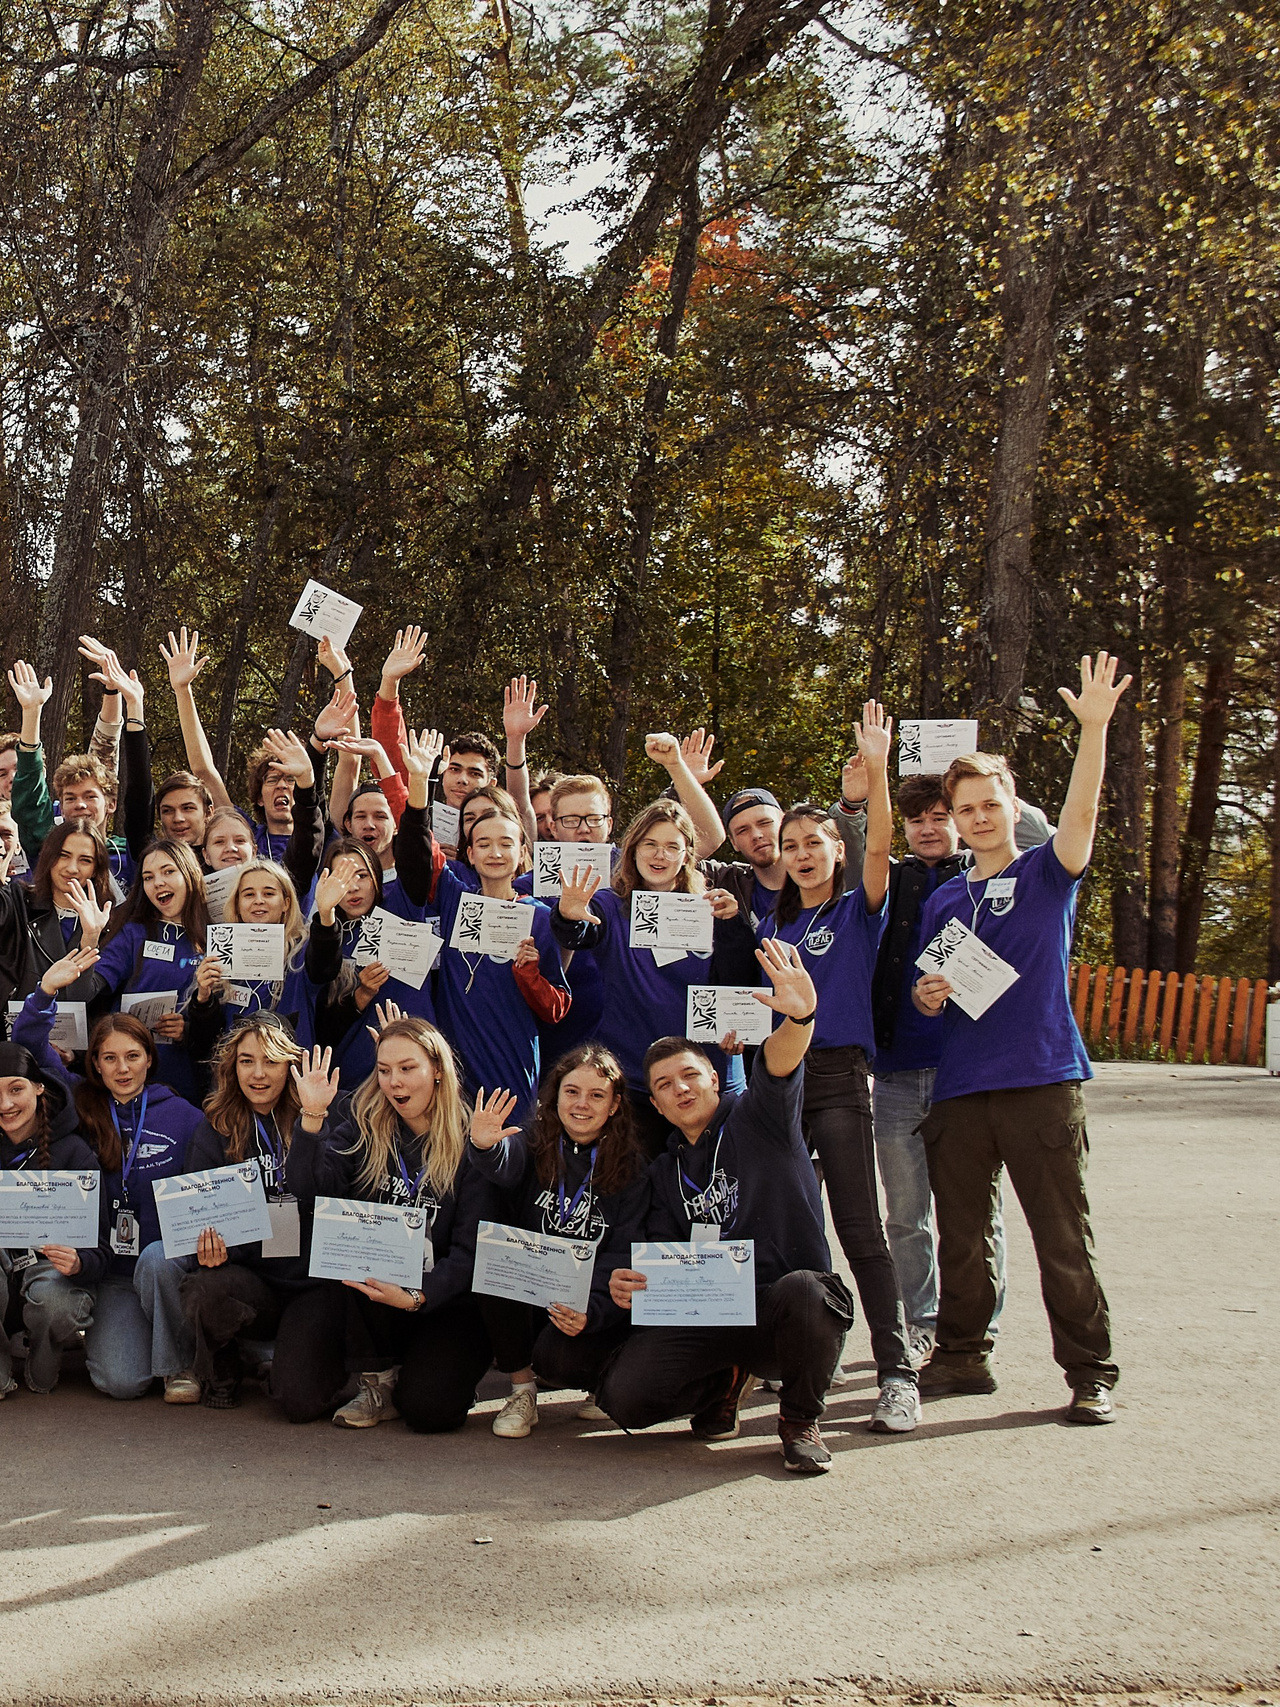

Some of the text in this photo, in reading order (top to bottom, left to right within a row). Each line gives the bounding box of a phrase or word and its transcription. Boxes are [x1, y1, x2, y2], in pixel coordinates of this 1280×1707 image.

[146, 943, 170, 956] СВЕТА
[234, 990, 248, 1002] ЕСЯ
[181, 1177, 235, 1191] БЛАГОДАРСТВЕННОЕ
[342, 1211, 398, 1222] БЛАГОДАРСТВЕННОЕ
[507, 1238, 565, 1254] БЛАГОДАРСТВЕННОЕ
[523, 1246, 548, 1256] ПИСЬМО
